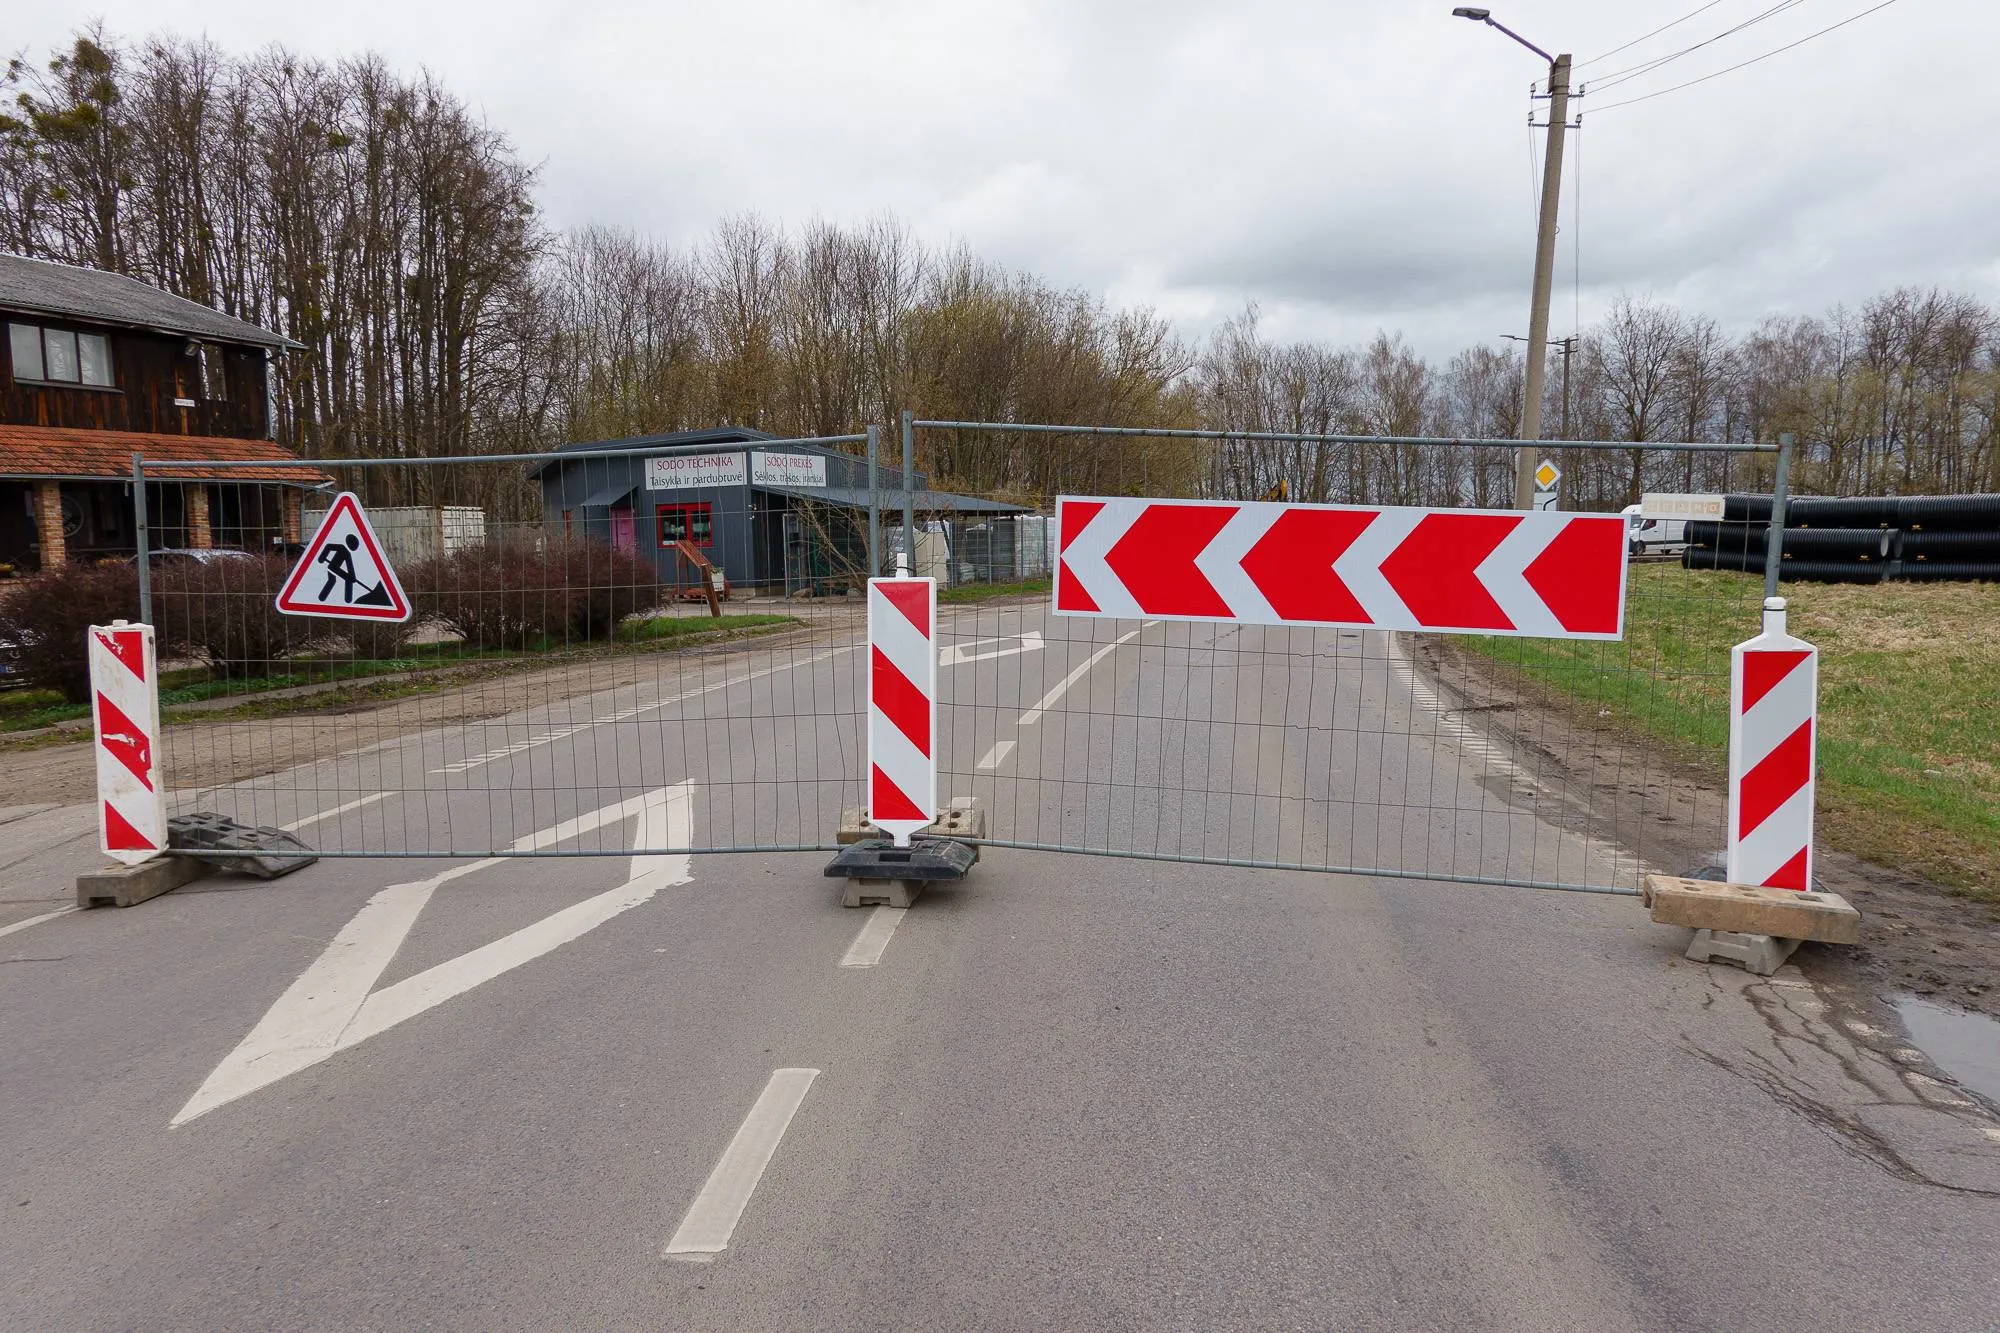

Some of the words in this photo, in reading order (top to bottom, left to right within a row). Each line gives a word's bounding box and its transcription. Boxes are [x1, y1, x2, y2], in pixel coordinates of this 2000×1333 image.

[657, 459, 684, 470] SODO
[687, 456, 733, 468] TECHNIKA
[767, 456, 787, 467] SODO
[650, 474, 681, 488] Taisykla
[684, 475, 689, 484] ir
[692, 472, 742, 486] parduotuvė
